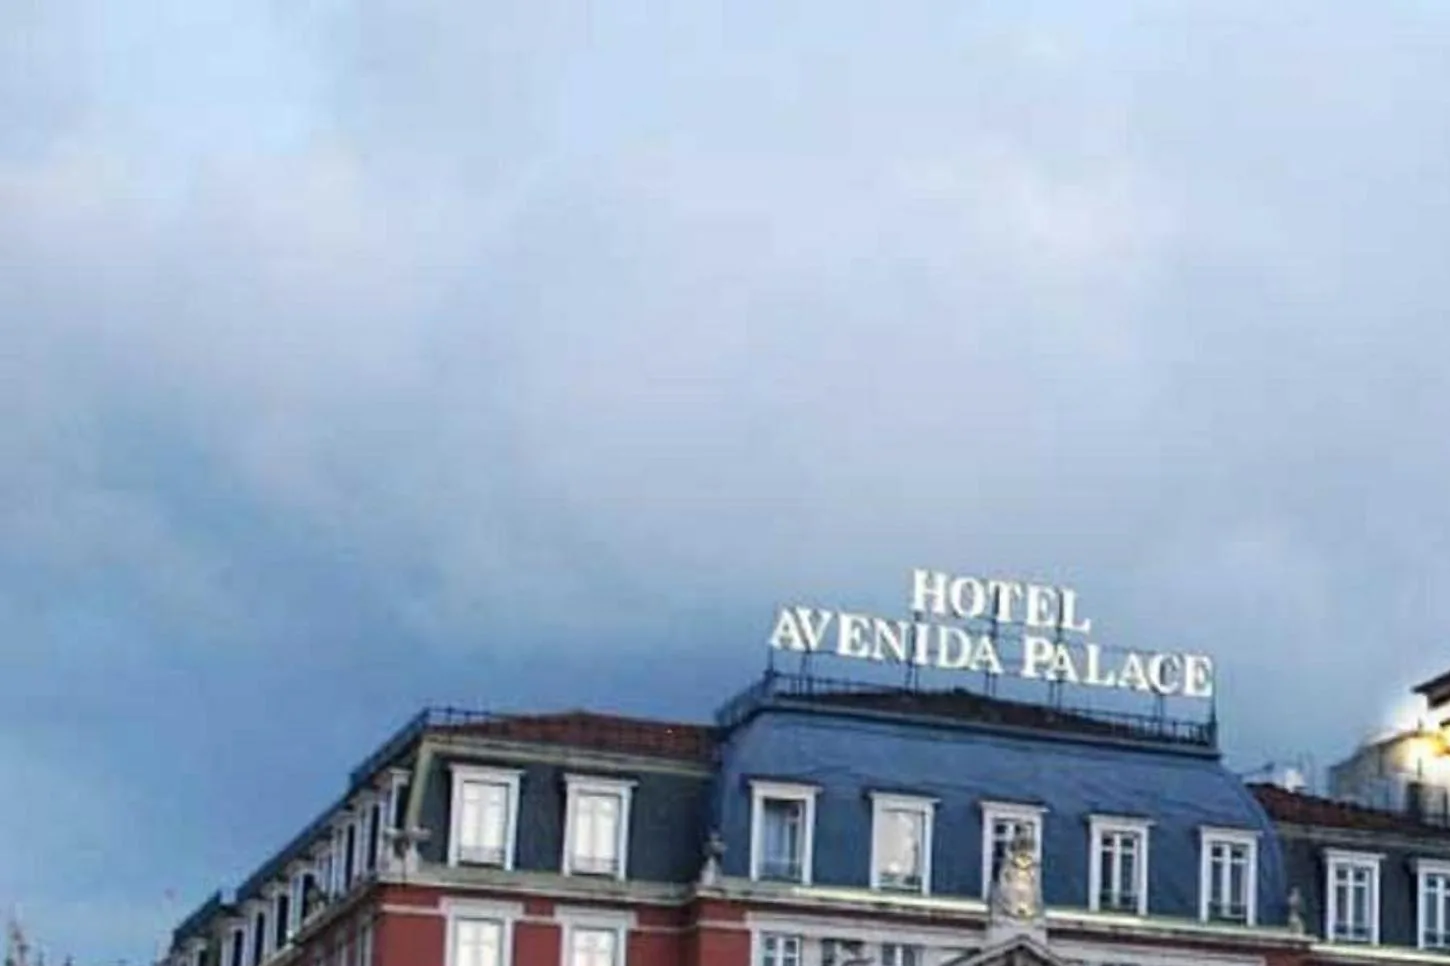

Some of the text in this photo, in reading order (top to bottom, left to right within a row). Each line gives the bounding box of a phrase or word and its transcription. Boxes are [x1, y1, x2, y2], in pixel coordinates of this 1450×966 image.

[911, 568, 1091, 633] HOTEL
[769, 606, 1213, 697] AVENIDA PALACE
